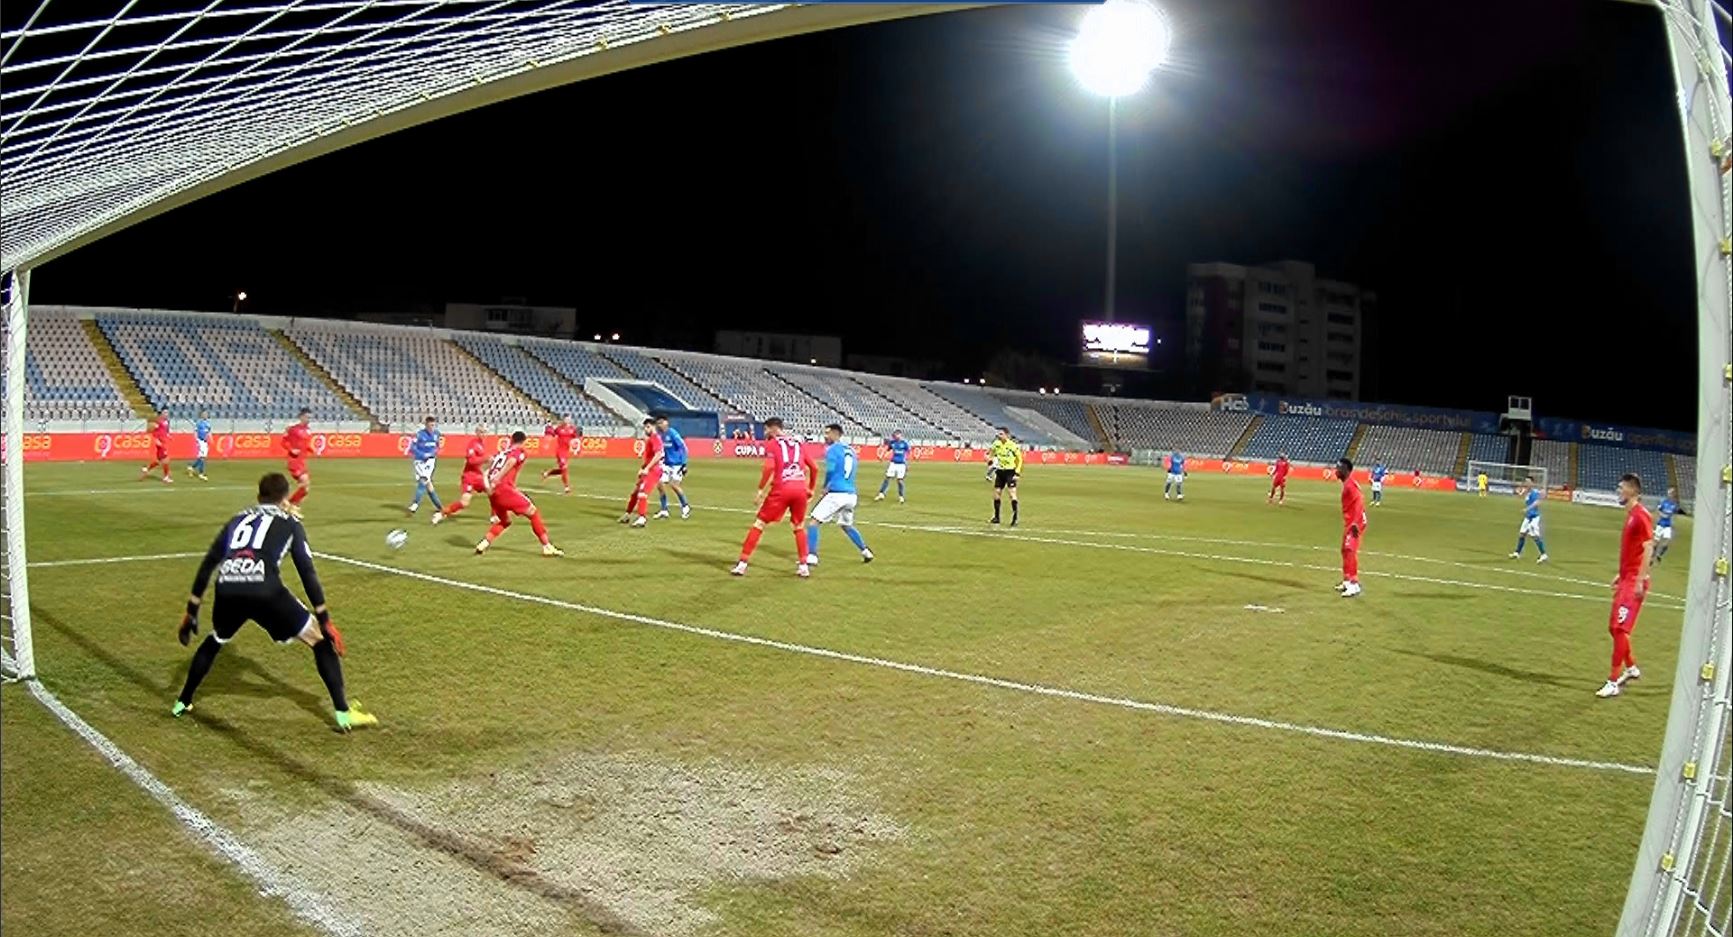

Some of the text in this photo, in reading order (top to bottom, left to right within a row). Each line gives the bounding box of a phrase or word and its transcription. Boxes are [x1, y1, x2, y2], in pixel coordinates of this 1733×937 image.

[113, 435, 151, 449] casa
[235, 435, 271, 449] casa
[328, 435, 362, 448] casa
[582, 437, 608, 450] casa
[735, 445, 757, 456] CUPA
[843, 446, 855, 480] 9
[229, 513, 274, 550] 61
